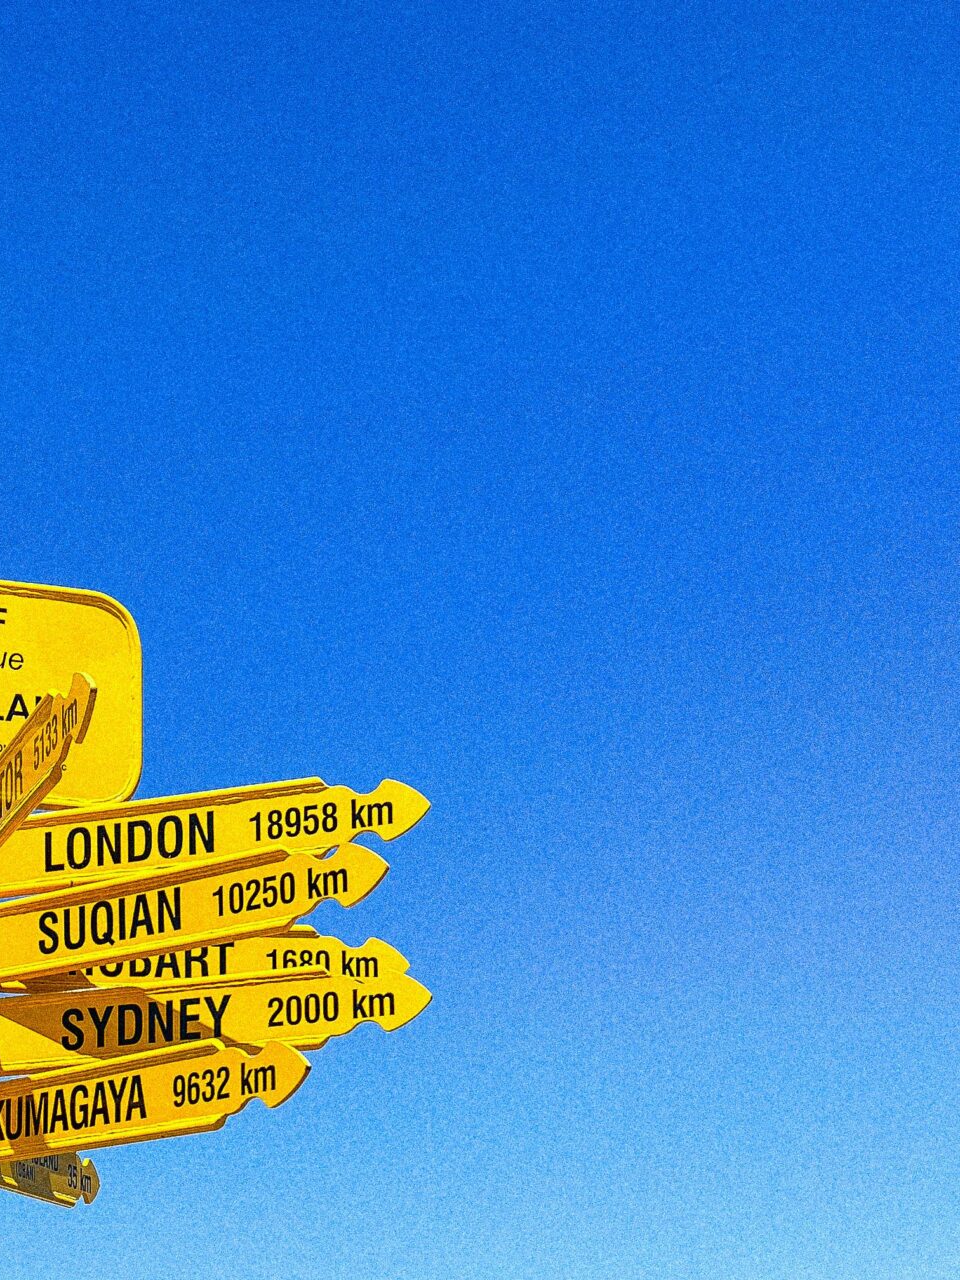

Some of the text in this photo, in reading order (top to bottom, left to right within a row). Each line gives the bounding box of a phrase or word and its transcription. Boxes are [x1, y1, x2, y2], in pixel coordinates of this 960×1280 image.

[33, 714, 58, 770] 5133
[61, 698, 78, 739] km
[44, 797, 394, 872] LONDON 18958 km
[38, 865, 348, 955] SUQIAN 10250 km
[341, 950, 378, 978] km
[61, 988, 395, 1052] SYDNEY 2000 km
[172, 1067, 230, 1108] 9632
[240, 1061, 276, 1095] km
